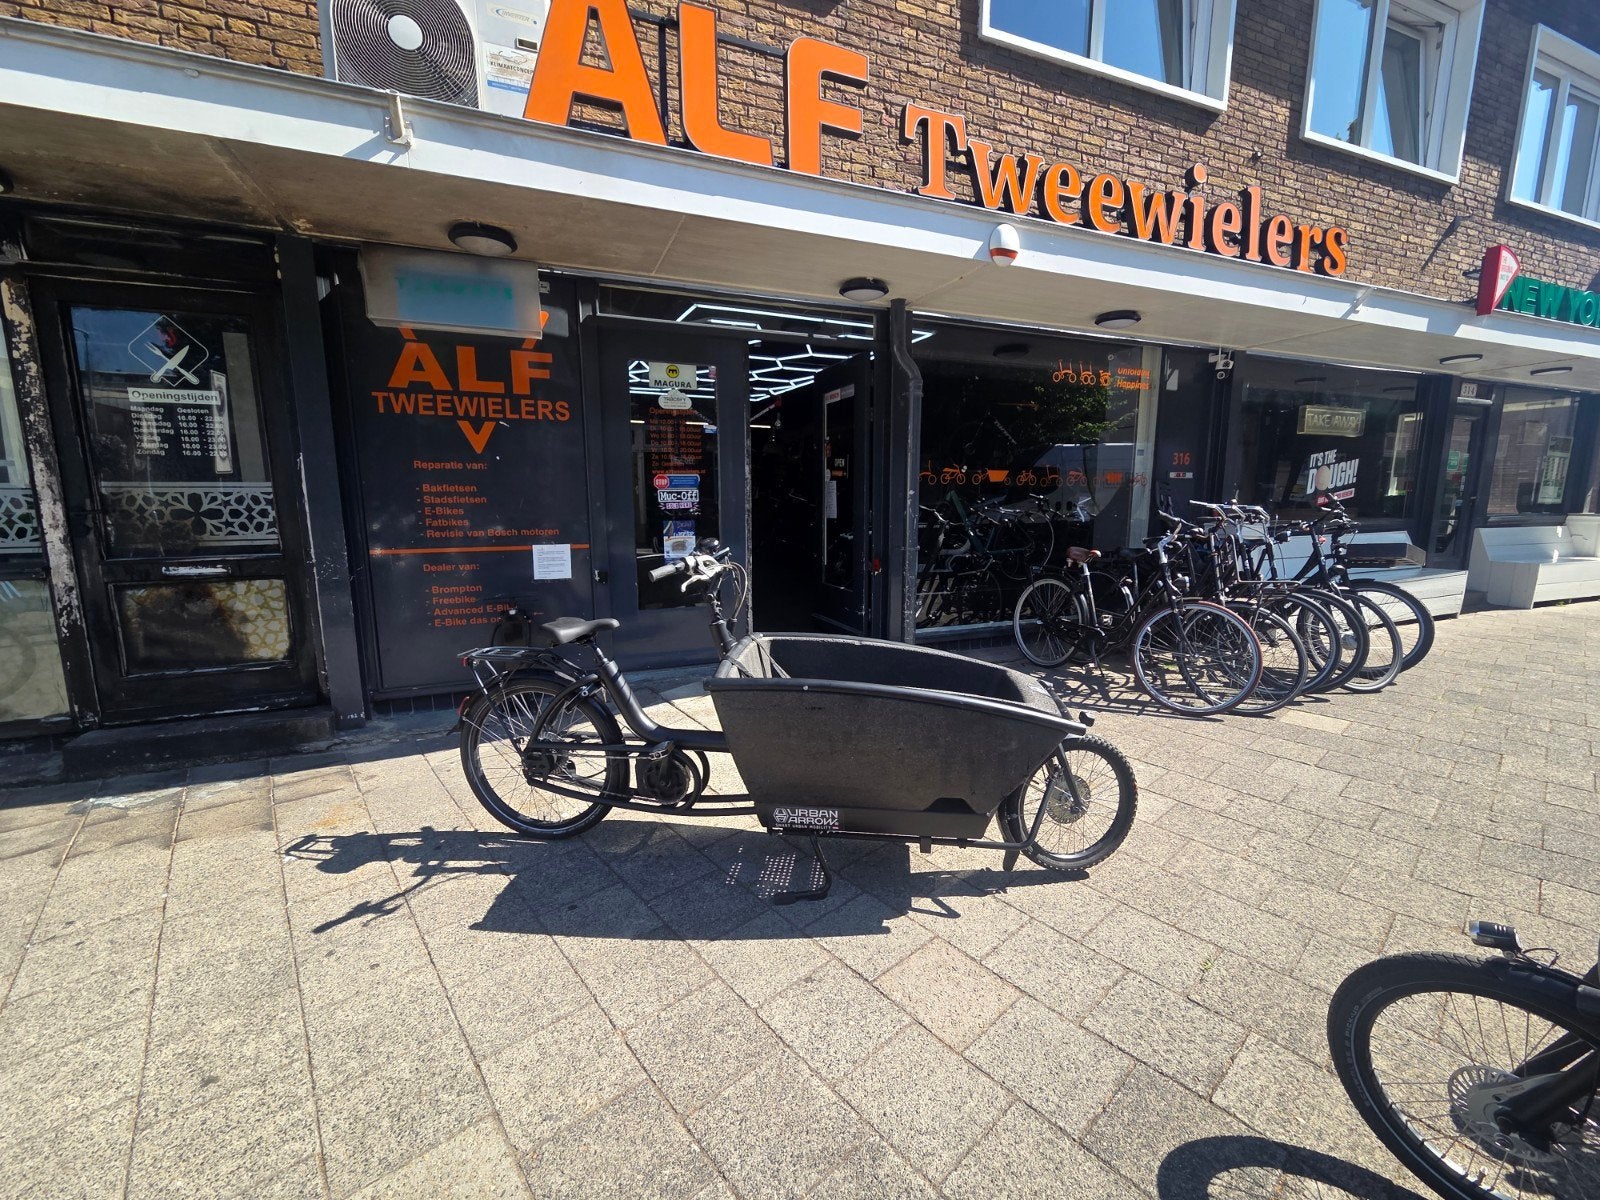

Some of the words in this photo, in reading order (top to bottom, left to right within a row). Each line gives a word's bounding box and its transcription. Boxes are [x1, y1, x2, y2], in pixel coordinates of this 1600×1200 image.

[490, 61, 534, 75] KLIMAATCONCEP
[523, 0, 869, 177] ALF
[904, 101, 1348, 277] Tweewielers
[1502, 274, 1566, 319] NEW
[1569, 288, 1600, 328] YO
[387, 341, 553, 395] ALF
[654, 380, 692, 388] MAGURA
[132, 390, 218, 402] Openingstijden
[371, 391, 571, 421] TWEEWIELERS
[1307, 414, 1331, 426] TAKE
[1334, 416, 1359, 428] AWAY
[1173, 452, 1190, 466] 316
[1310, 452, 1324, 468] IT'S
[1324, 449, 1337, 465] THE
[414, 460, 463, 471] Reparatie
[466, 461, 488, 470] van:
[422, 483, 477, 493] Bakfietsen
[423, 495, 487, 504] Stadsfietsen
[660, 492, 697, 501] Muc-Off
[425, 506, 464, 516] E-Bikes
[426, 518, 469, 528] Fatbikes
[426, 529, 464, 538] Revisie
[488, 528, 518, 537] Bosch
[423, 563, 456, 572] Dealer
[459, 563, 480, 571] van:
[432, 584, 482, 596] Brompton
[433, 596, 476, 605] Freebike
[434, 606, 483, 616] Advanced
[434, 618, 468, 628] E-Bike
[470, 616, 488, 625] das
[787, 808, 838, 818] URBAN
[788, 817, 838, 825] ARROW
